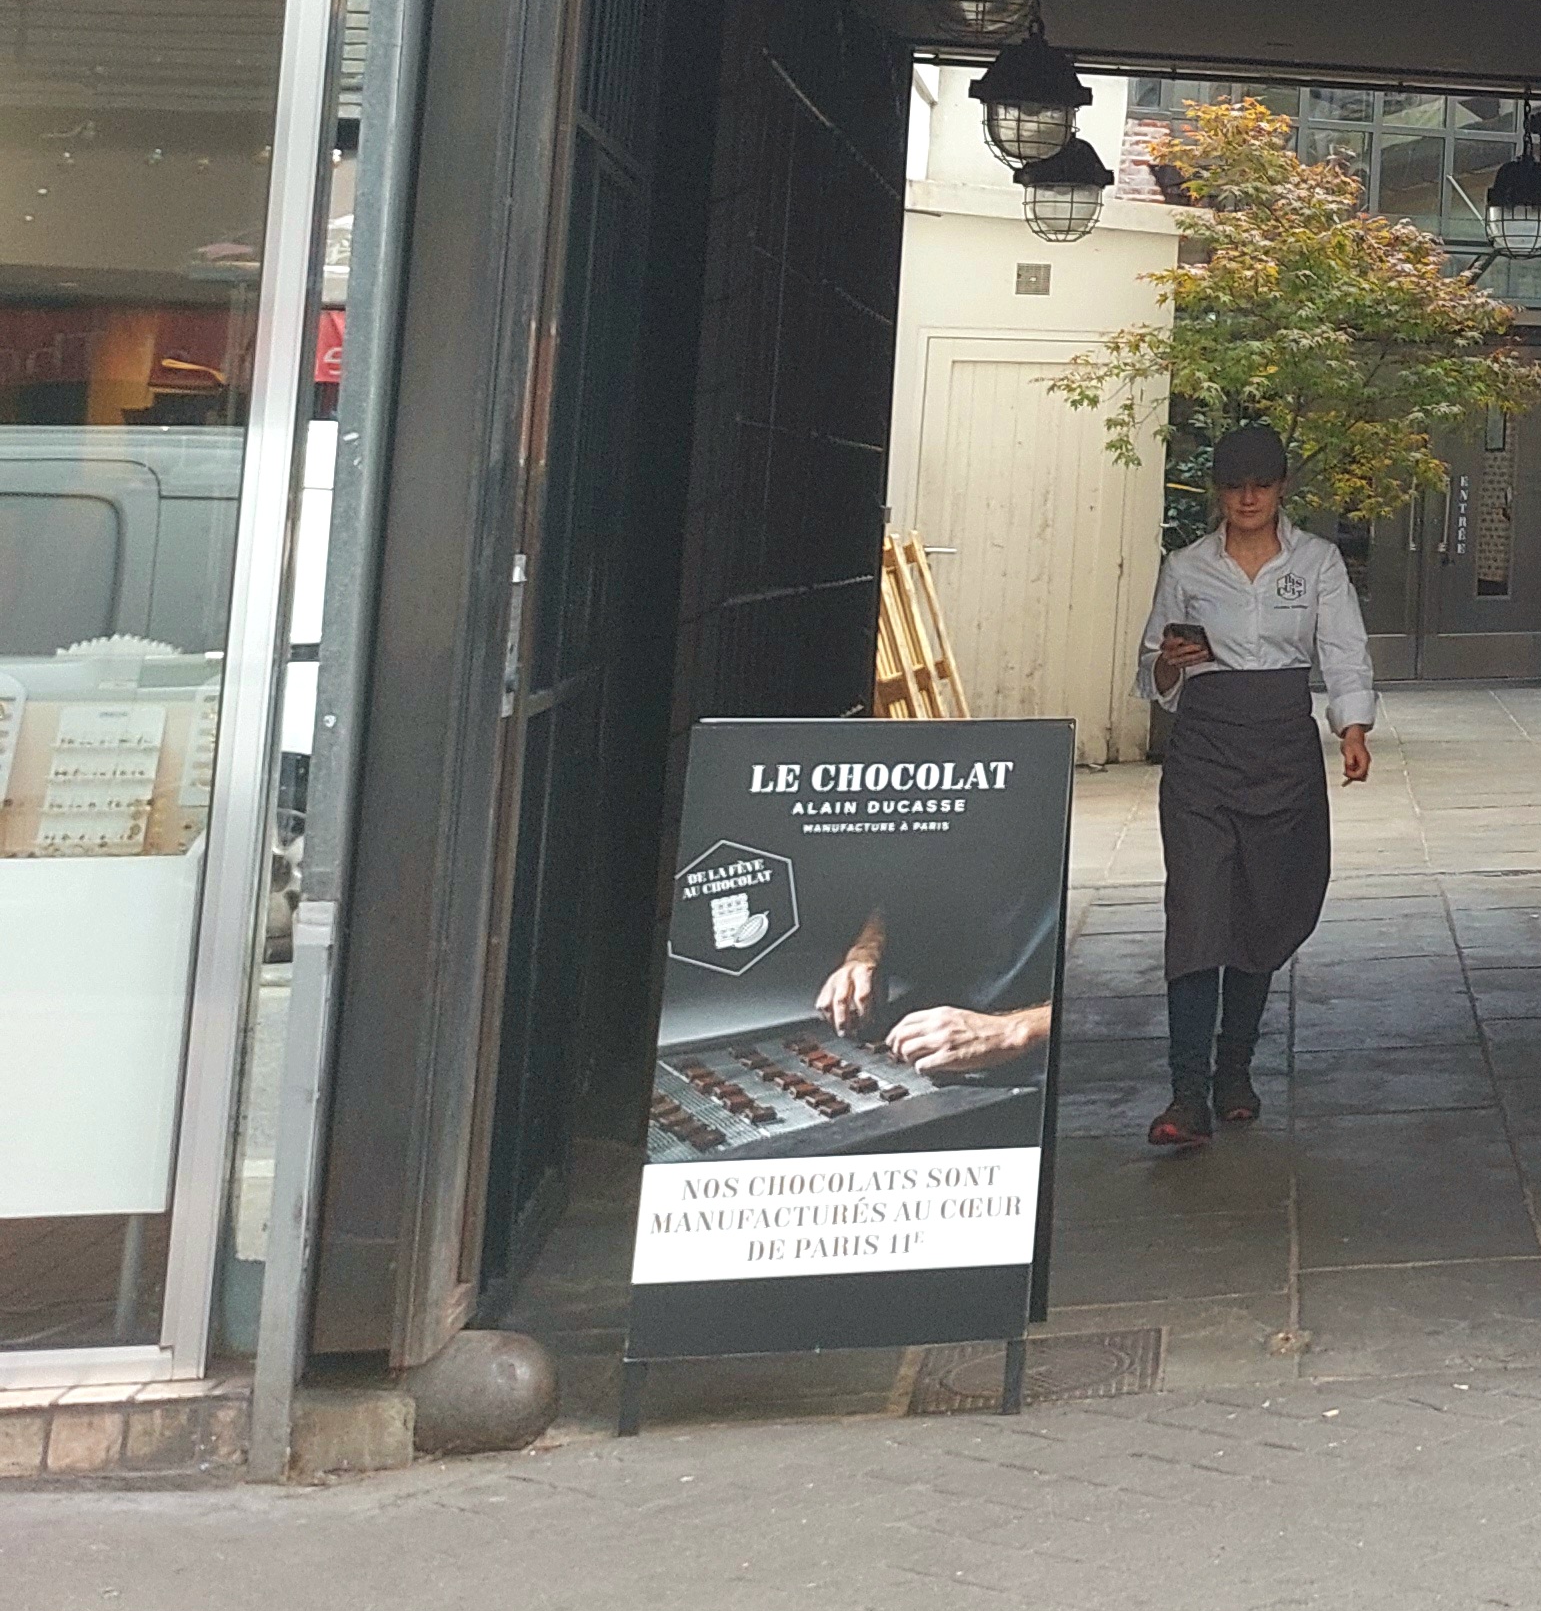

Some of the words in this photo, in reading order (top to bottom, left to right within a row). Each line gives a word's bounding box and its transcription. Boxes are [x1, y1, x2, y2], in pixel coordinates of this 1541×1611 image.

[749, 763, 801, 794] LE
[811, 761, 1014, 792] CHOCOLAT
[792, 801, 857, 816] ALAIN
[867, 798, 967, 814] DUCASSE
[803, 822, 896, 834] MANUFACTURE
[912, 820, 950, 832] PARIS
[682, 886, 701, 900] AU
[702, 870, 773, 894] CHOCOLAT
[686, 871, 707, 885] DE
[708, 867, 727, 880] LA
[681, 1177, 740, 1201] NOS
[747, 1168, 918, 1199] CHOCOLATS
[925, 1164, 1001, 1190] SONT
[649, 1196, 887, 1235] MANUFACTURÉS
[893, 1199, 932, 1222] AU
[747, 1238, 785, 1262] DE
[794, 1233, 880, 1259] PARIS
